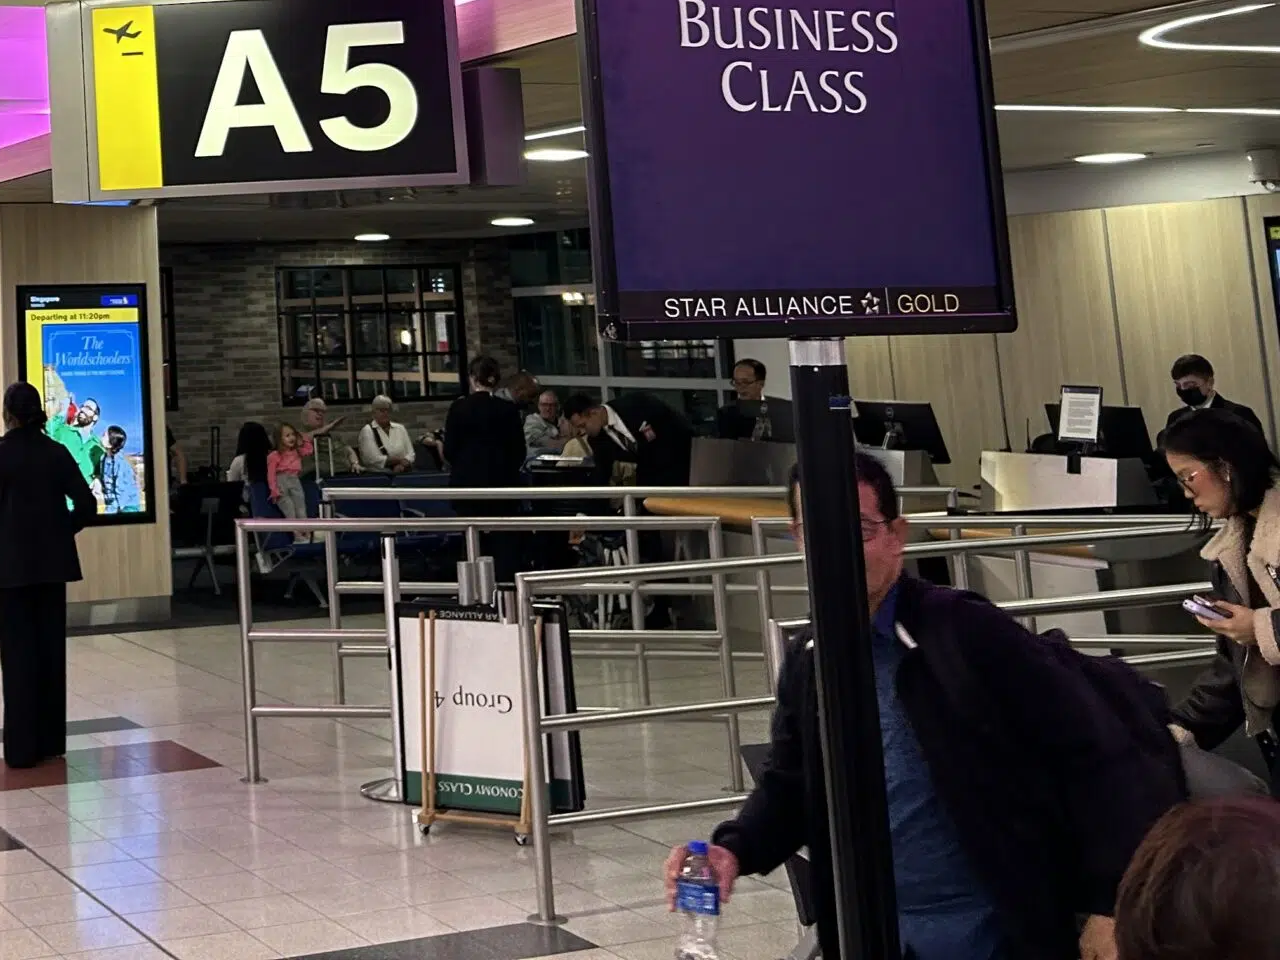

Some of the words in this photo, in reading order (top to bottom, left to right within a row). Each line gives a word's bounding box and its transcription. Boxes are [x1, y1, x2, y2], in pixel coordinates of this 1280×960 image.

[194, 20, 419, 158] A5
[721, 60, 868, 114] CLASS
[664, 297, 727, 318] STAR
[735, 294, 854, 319] ALLIANCE
[897, 293, 960, 315] GOLD
[30, 313, 68, 321] Departing
[69, 312, 77, 320] at
[81, 335, 105, 351] The
[439, 609, 484, 620] ALLIANCE
[452, 684, 513, 715] Group
[438, 780, 473, 796] CLASS
[475, 783, 524, 799] CONOMY
